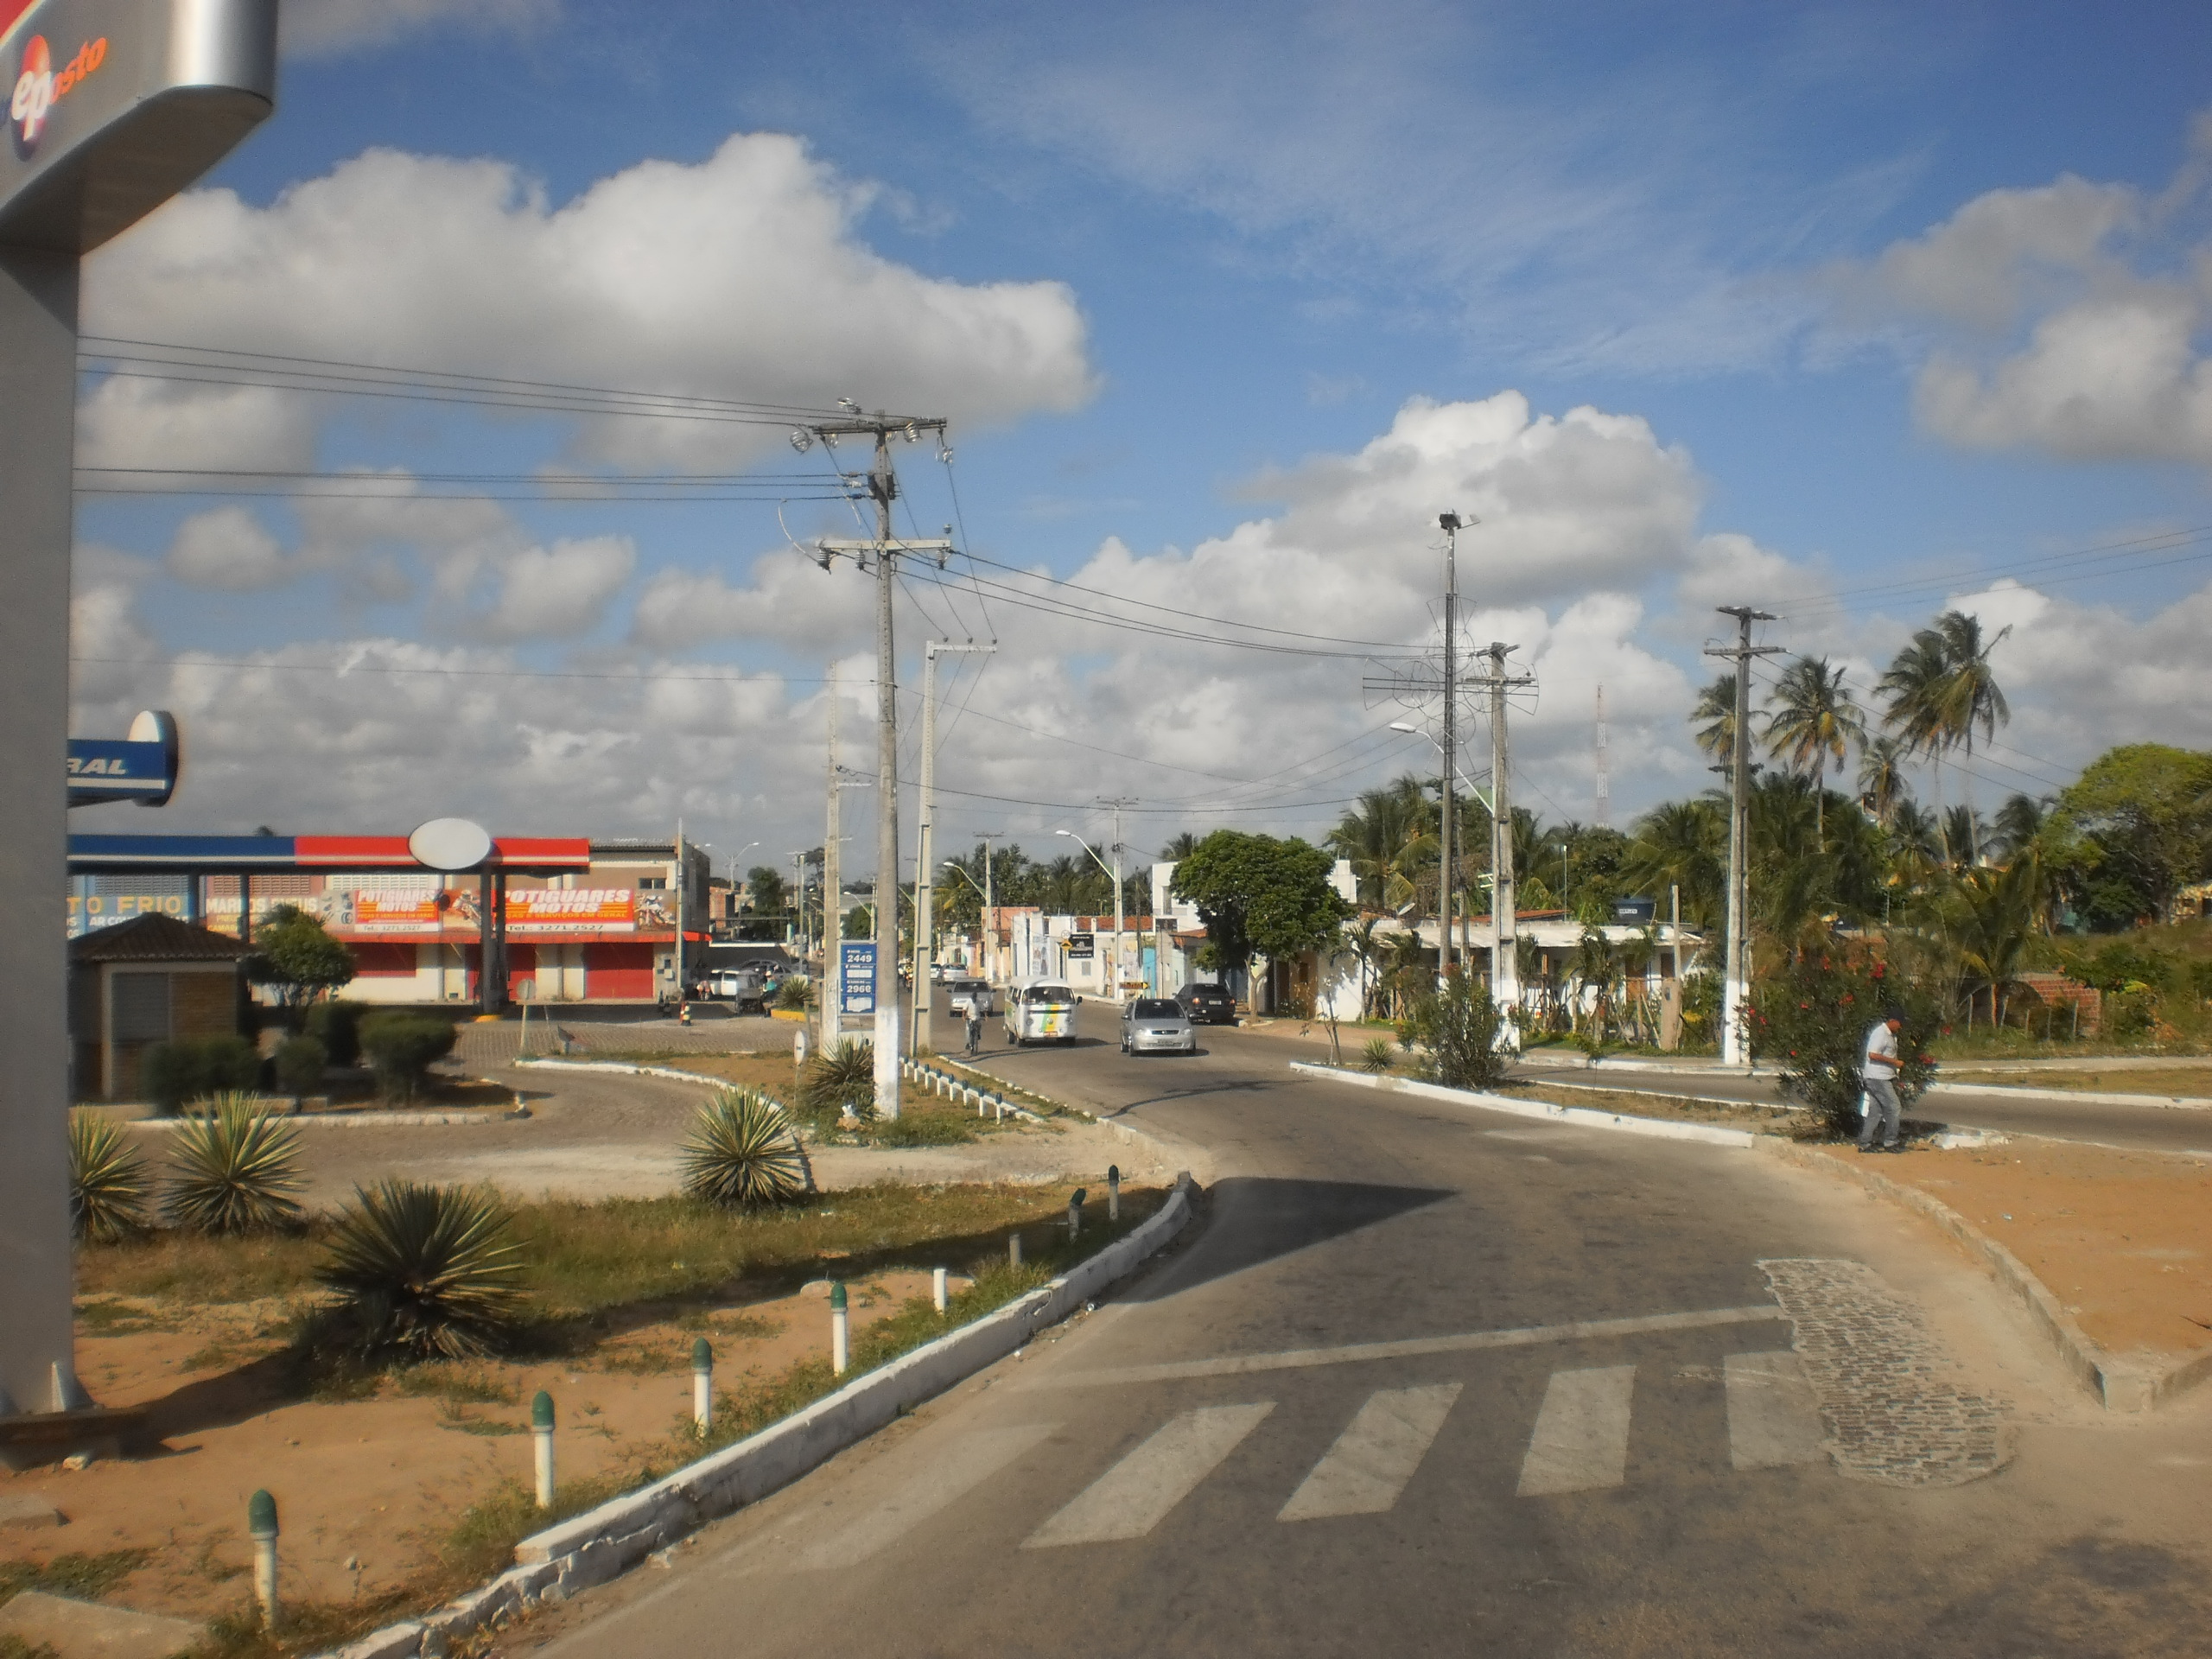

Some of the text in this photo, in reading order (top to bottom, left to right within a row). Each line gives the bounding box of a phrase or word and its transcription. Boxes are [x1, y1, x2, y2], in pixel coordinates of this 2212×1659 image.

[357, 890, 435, 902] POTIGUARES
[116, 895, 181, 914] FRIO
[206, 896, 318, 913] MAROS PUS
[375, 902, 416, 912] MOTOS
[528, 903, 600, 913] MOTOS
[847, 954, 873, 963] 2449
